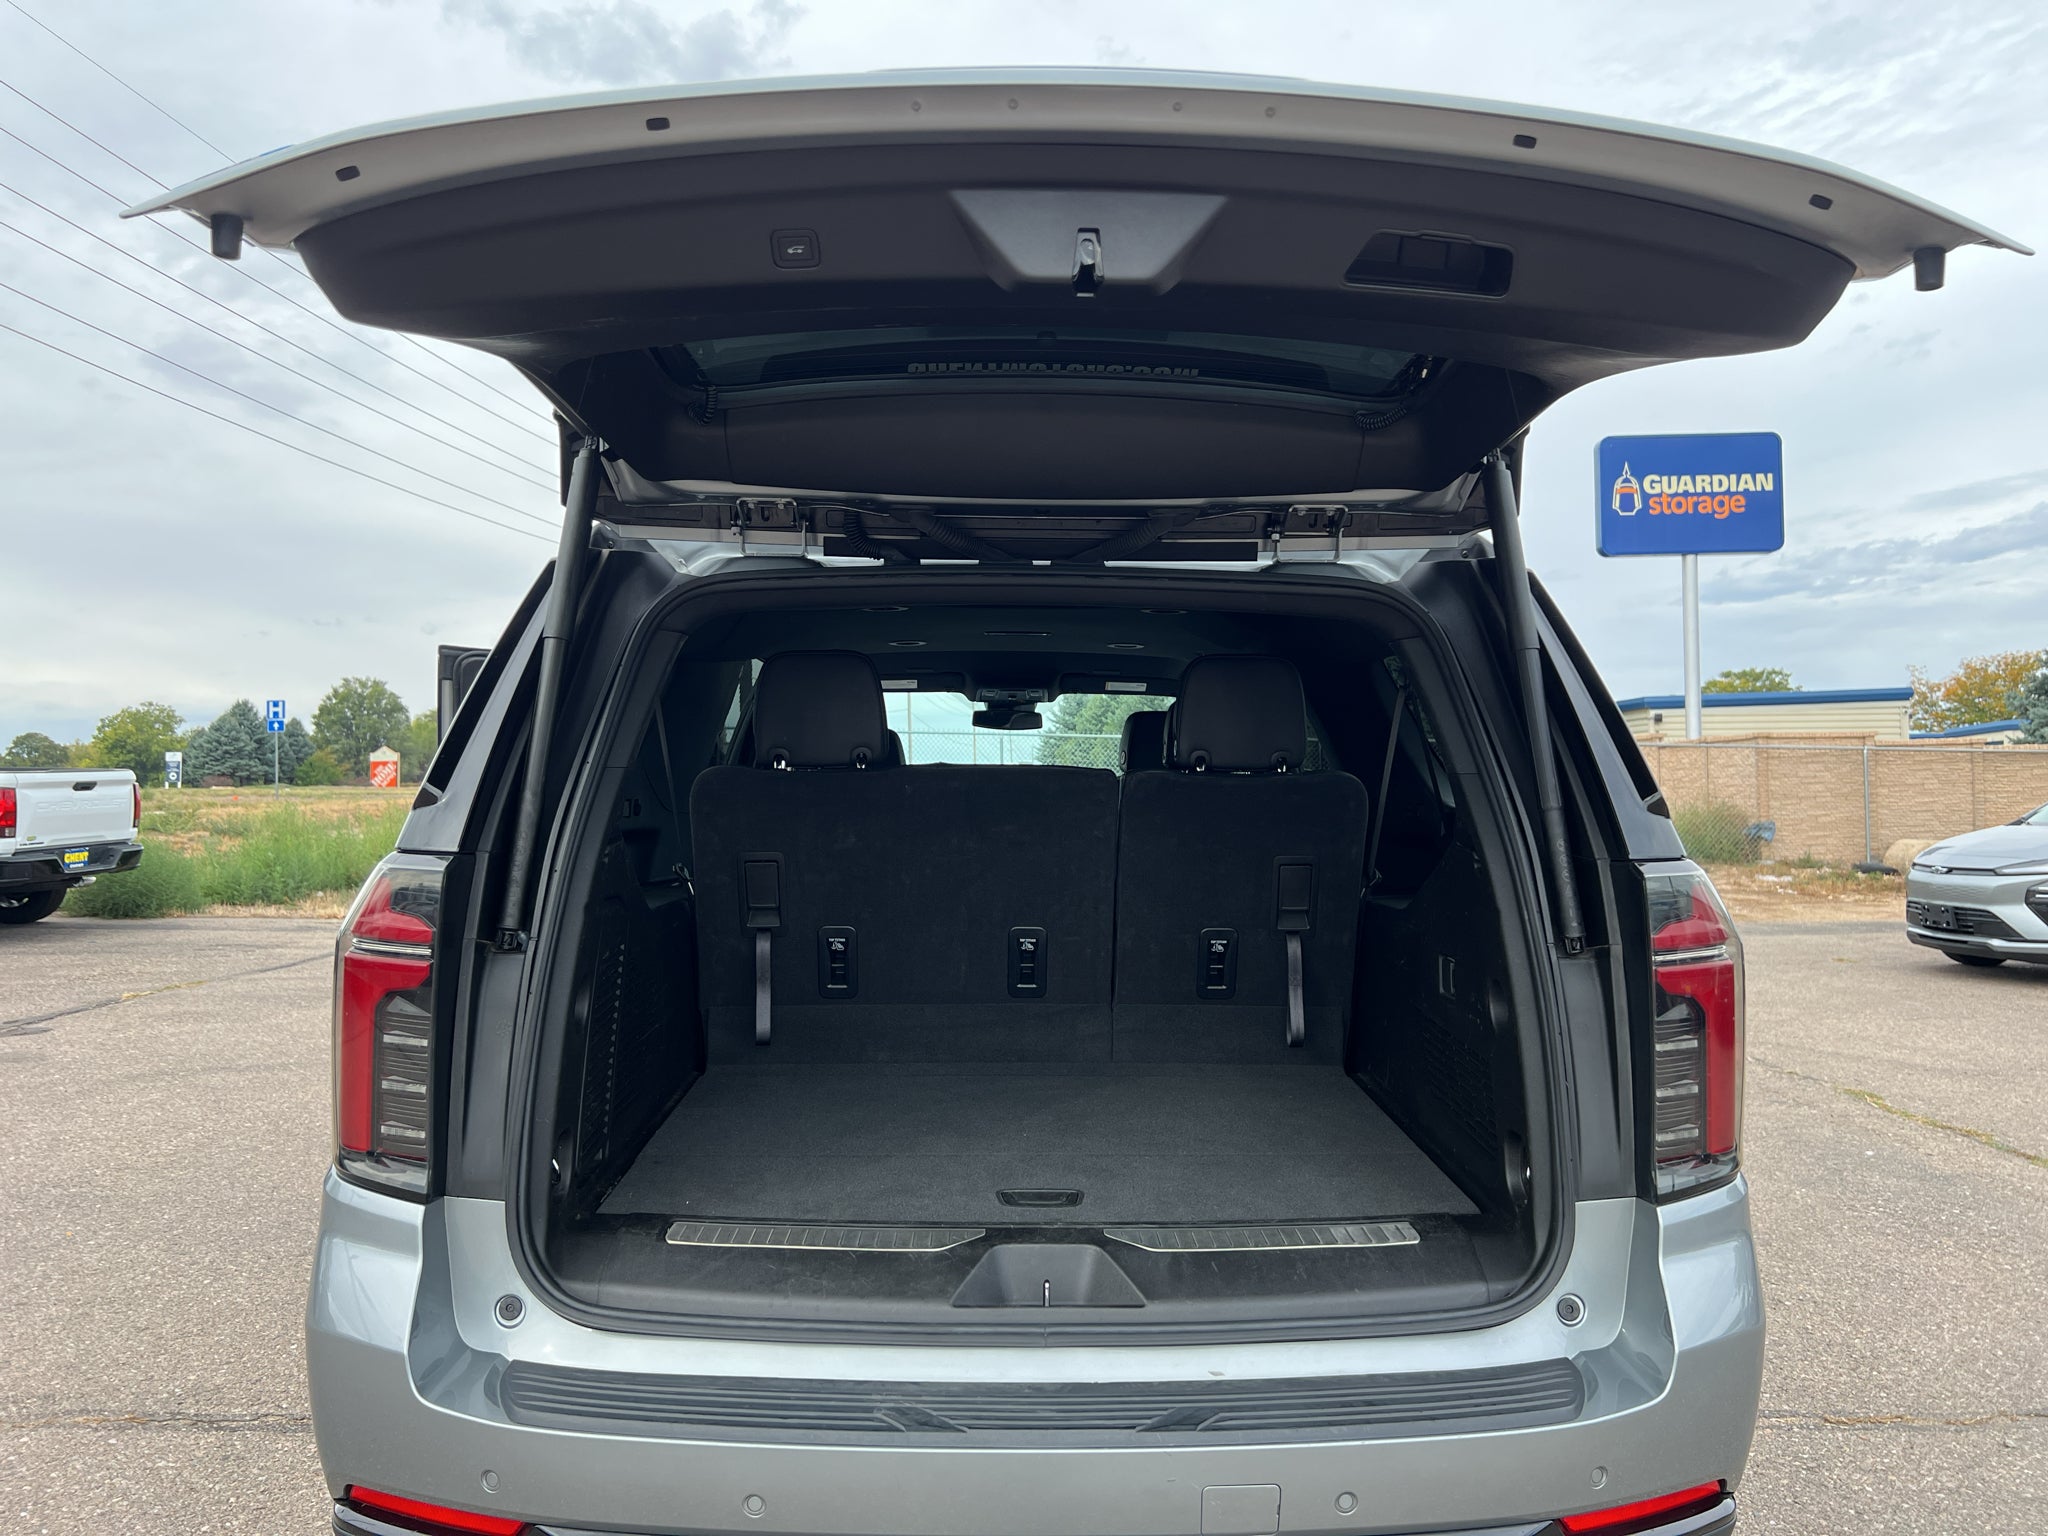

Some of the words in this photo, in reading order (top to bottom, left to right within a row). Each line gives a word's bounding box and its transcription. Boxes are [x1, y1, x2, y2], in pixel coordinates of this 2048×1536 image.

[1643, 473, 1774, 494] GUARDIAN
[1649, 493, 1746, 519] storage
[269, 701, 282, 719] H
